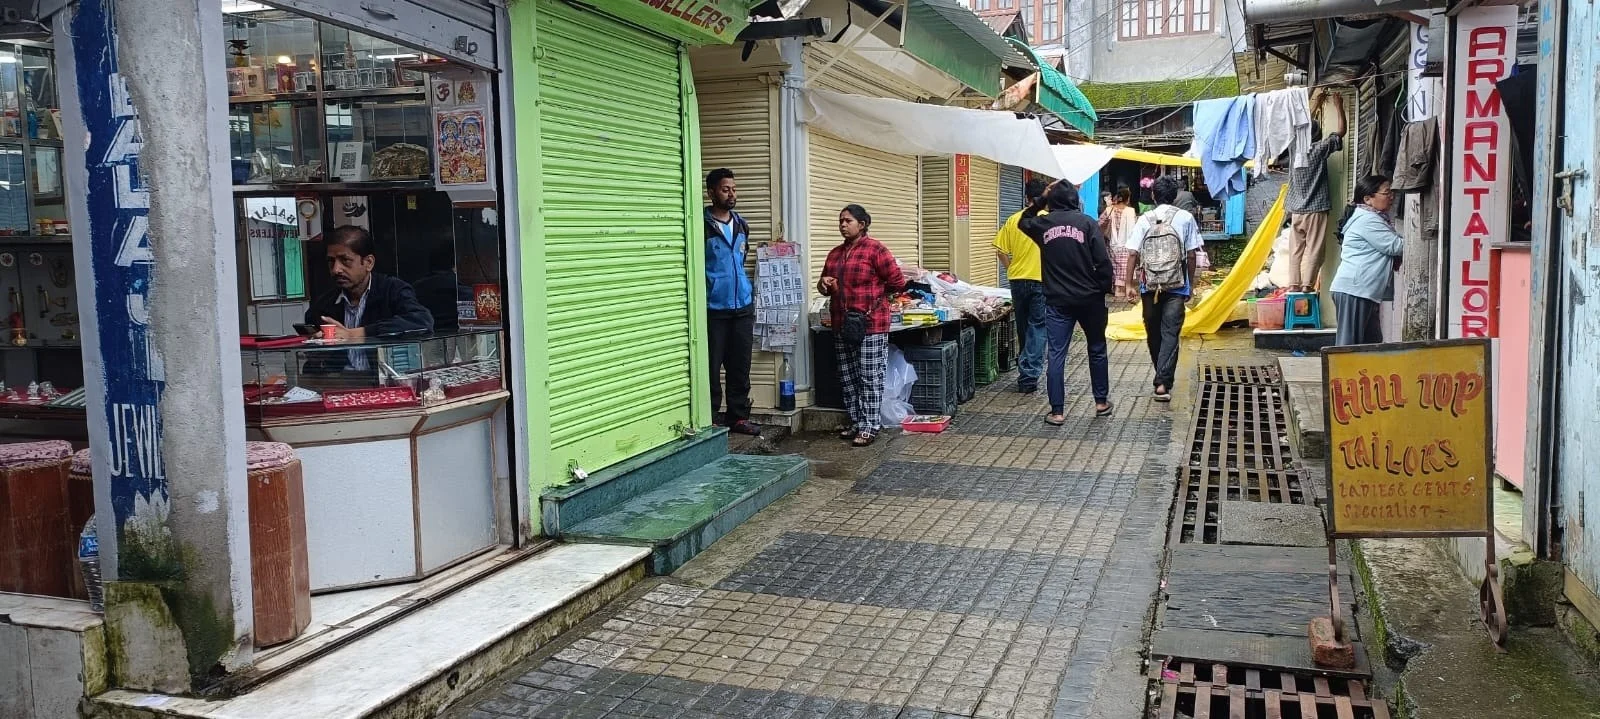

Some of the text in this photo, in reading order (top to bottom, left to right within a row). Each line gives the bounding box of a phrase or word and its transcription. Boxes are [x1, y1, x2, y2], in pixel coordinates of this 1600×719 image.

[1461, 26, 1507, 337] ARMAN TAILOR
[1043, 225, 1085, 245] CHICAGO
[1416, 371, 1483, 418] TOP
